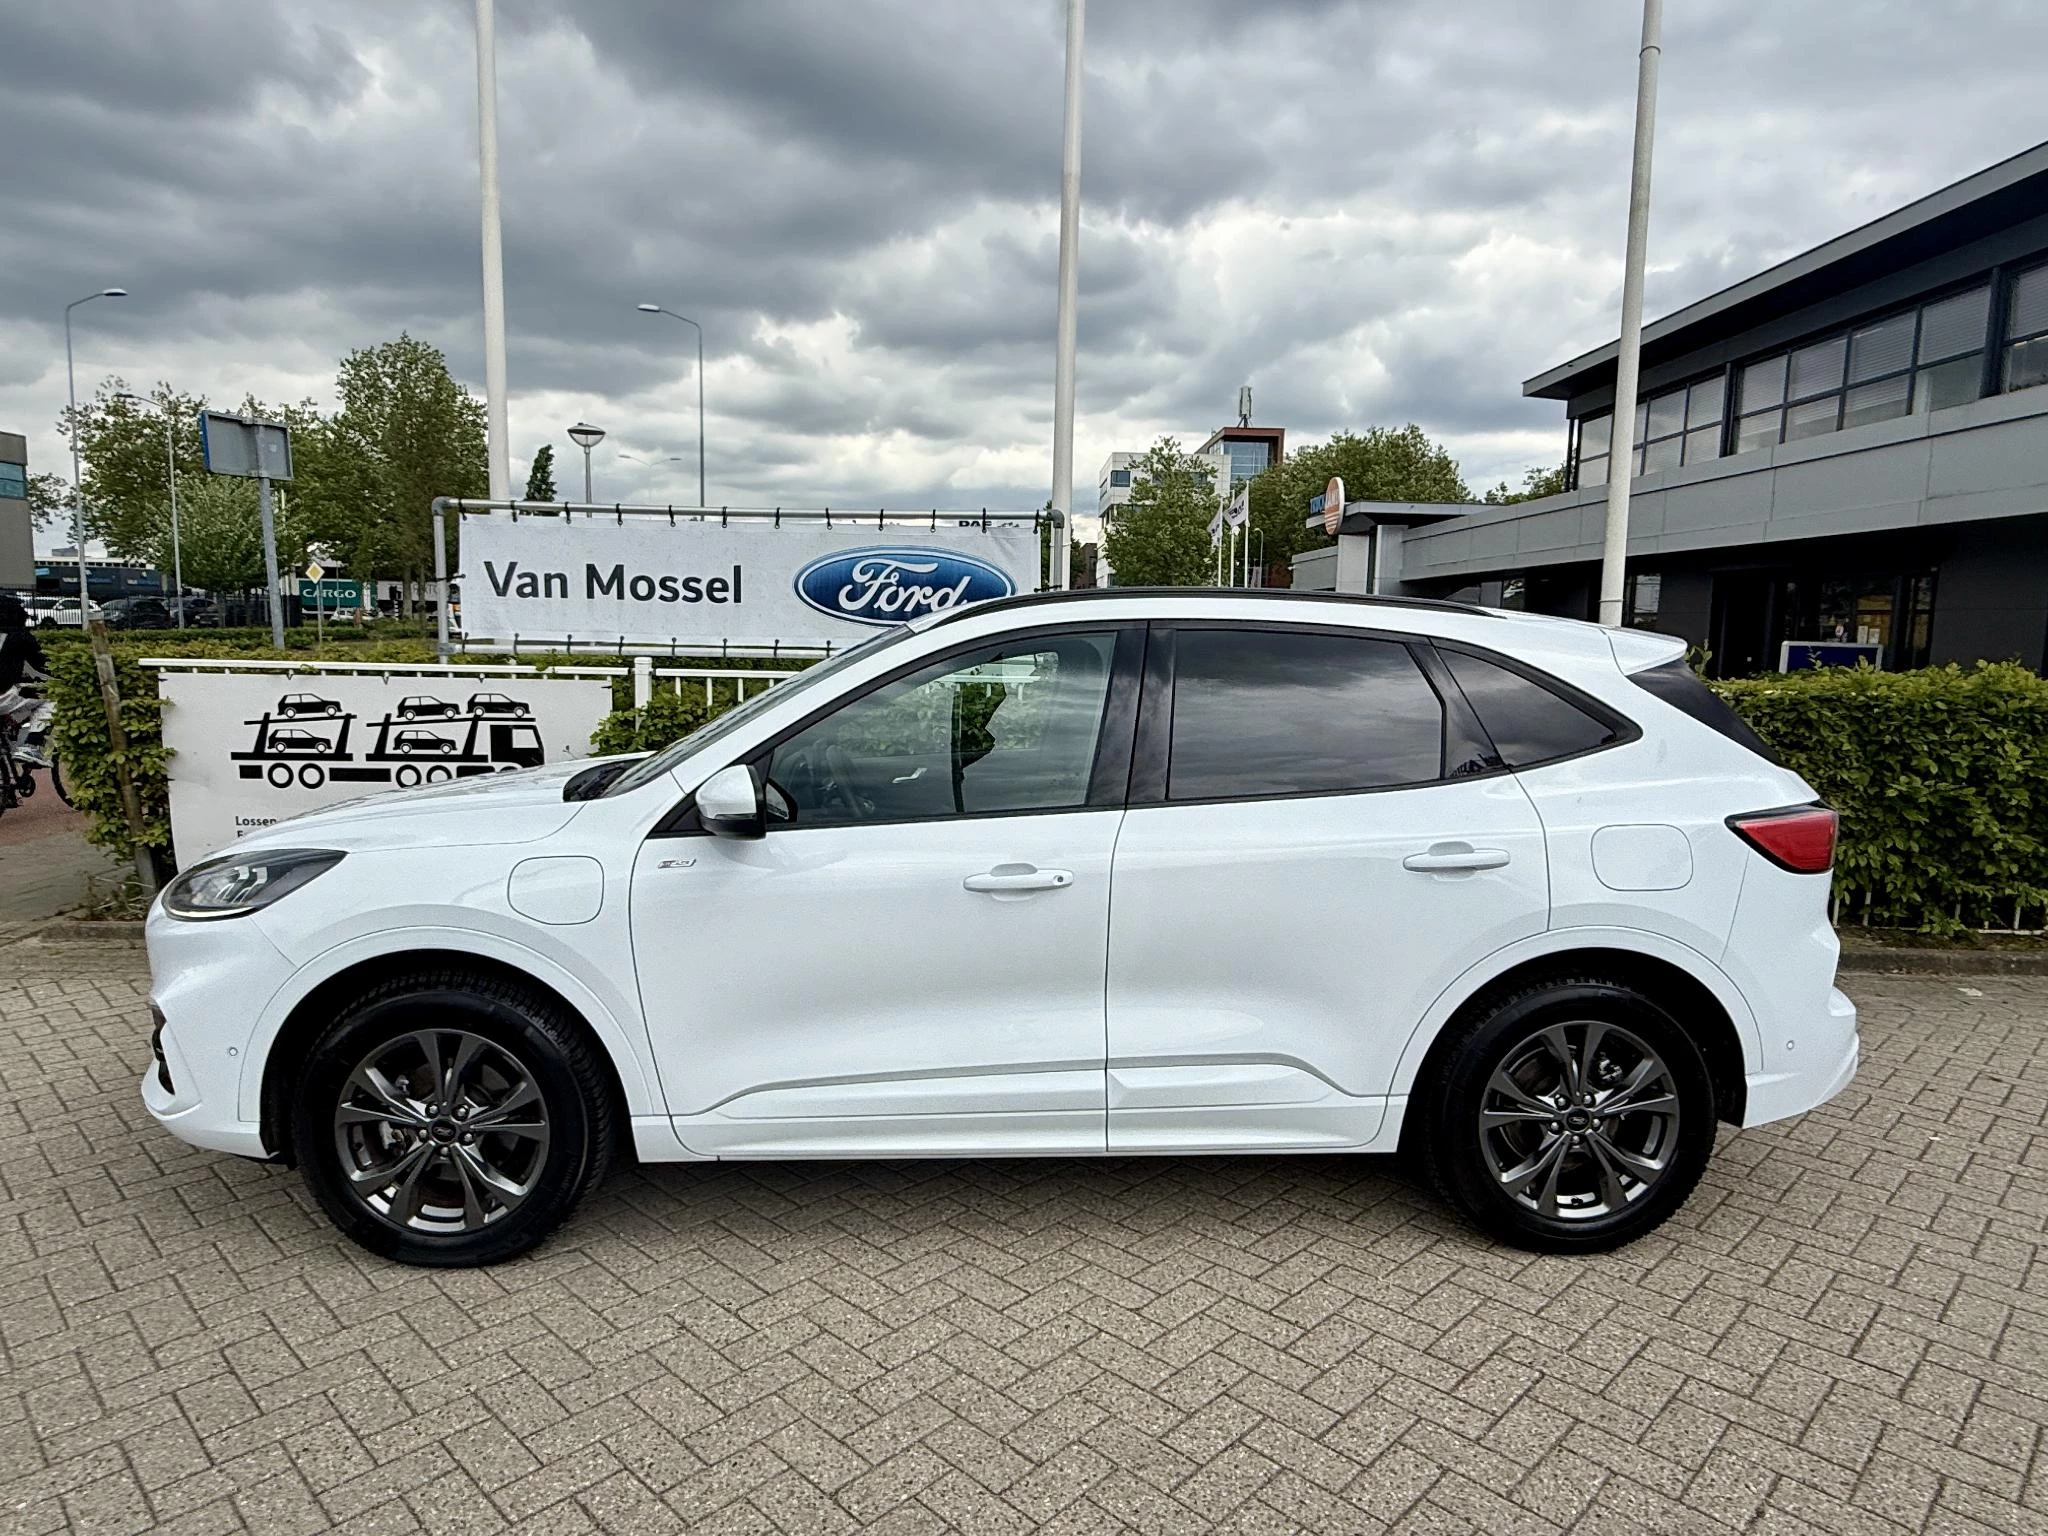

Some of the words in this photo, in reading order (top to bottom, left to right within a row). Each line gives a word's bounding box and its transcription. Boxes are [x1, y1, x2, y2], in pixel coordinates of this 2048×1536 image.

[302, 588, 357, 599] CARGO
[483, 560, 569, 599] Van
[585, 563, 743, 604] Mossel
[838, 558, 972, 613] Ford
